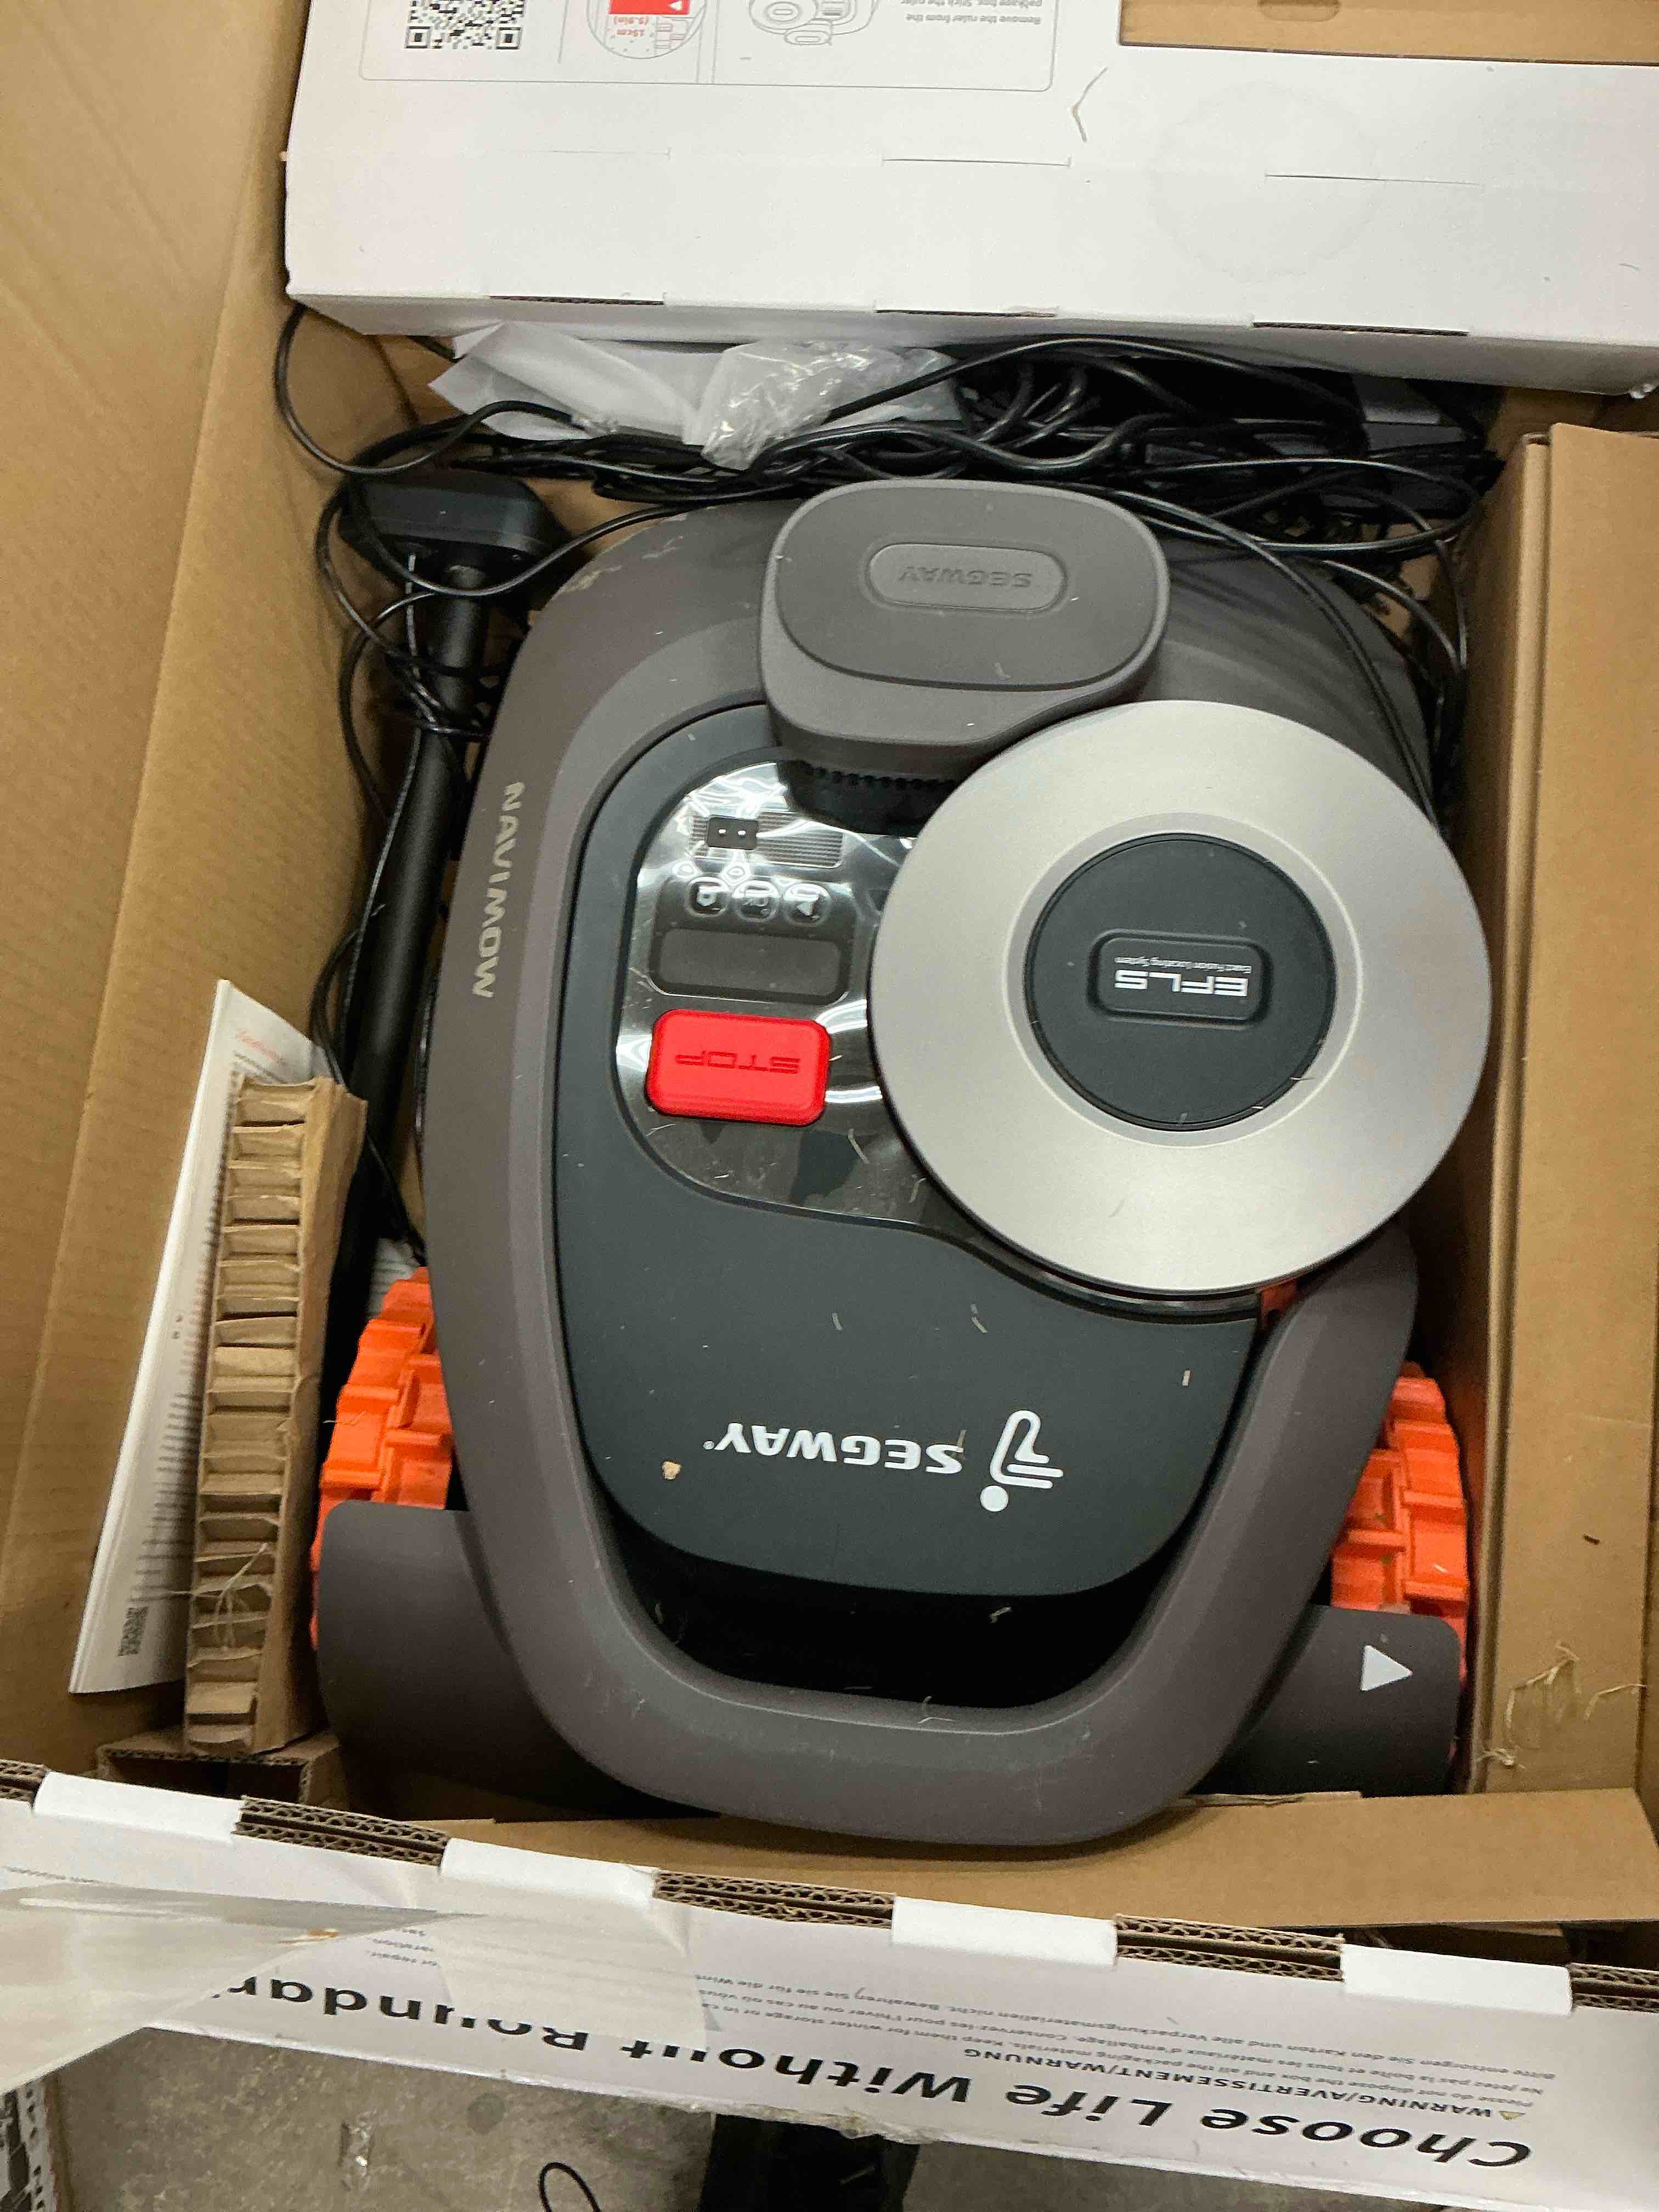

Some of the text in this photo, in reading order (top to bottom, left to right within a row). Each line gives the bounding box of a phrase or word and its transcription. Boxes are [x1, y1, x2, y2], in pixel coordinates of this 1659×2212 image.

[905, 14, 923, 22] the
[926, 14, 950, 24] from
[980, 15, 997, 24] the
[998, 16, 1041, 25] Remove
[898, 566, 1033, 588] SEGWAY
[472, 781, 525, 998] NAVIMOW
[1114, 969, 1248, 997] EFLS
[675, 1051, 800, 1074] STOP
[714, 1423, 963, 1475] SEGWAY
[737, 1980, 763, 1990] die
[766, 1999, 795, 2007] cas
[211, 1976, 589, 2051] Boundar
[765, 2012, 826, 2024] storage
[830, 2021, 882, 2031] winter
[907, 2017, 945, 2026] pour
[887, 2028, 910, 2036] for
[914, 2031, 957, 2041] them
[962, 2036, 1003, 2046] Keep
[1211, 2036, 1244, 2045] alle
[1247, 2040, 1282, 2049] und
[1287, 2046, 1347, 2056] Karton
[1097, 2051, 1183, 2067] packaging
[1389, 2057, 1414, 2065] Sie
[1187, 2063, 1214, 2072] the
[1277, 2060, 1302, 2069] les
[1307, 2063, 1344, 2072] tous
[1282, 2074, 1311, 2082] box
[1005, 2085, 1172, 2127] Life
[1479, 2097, 1533, 2108] Please
[1200, 2109, 1532, 2167] Choose
